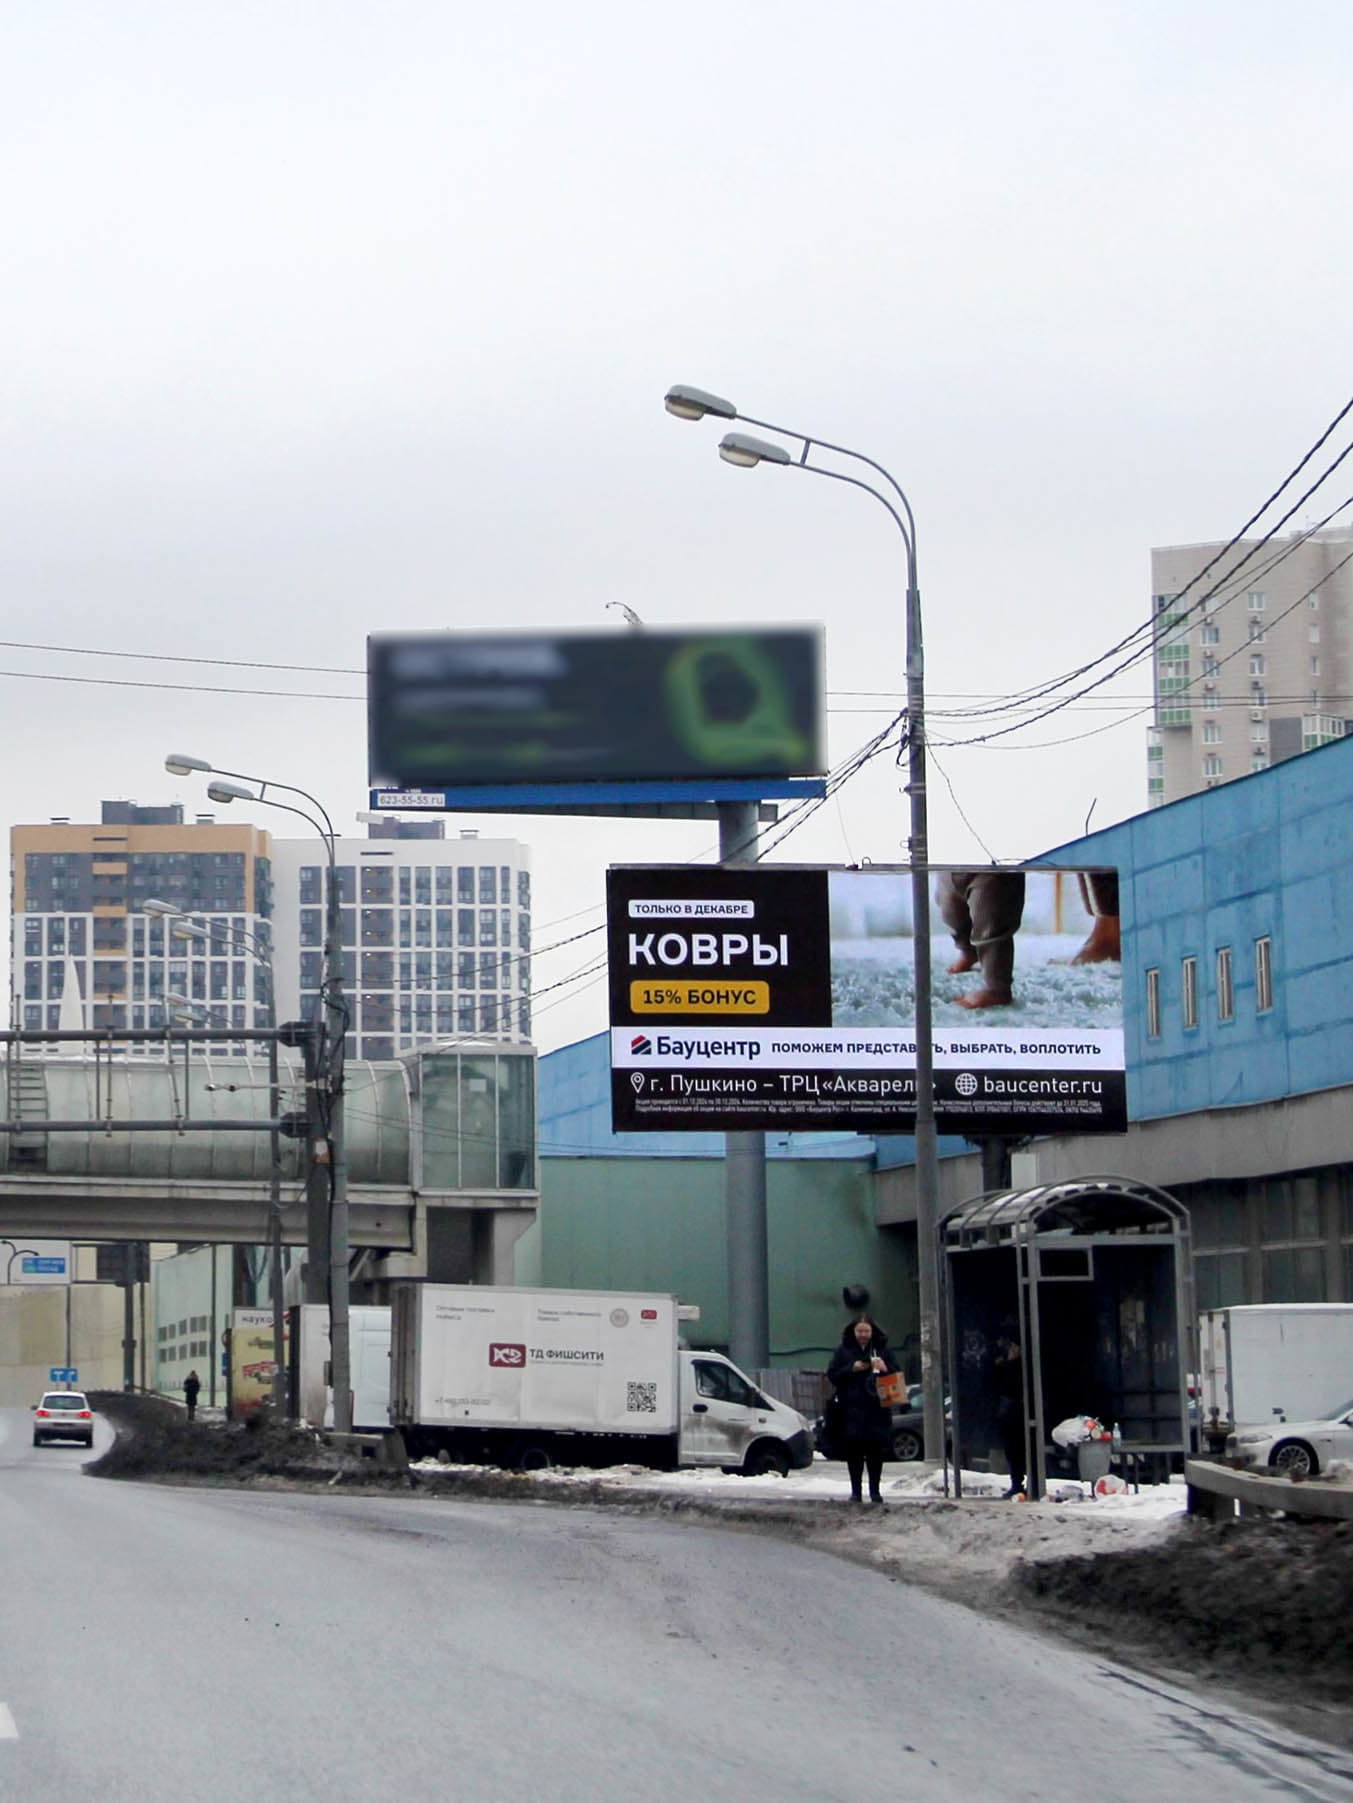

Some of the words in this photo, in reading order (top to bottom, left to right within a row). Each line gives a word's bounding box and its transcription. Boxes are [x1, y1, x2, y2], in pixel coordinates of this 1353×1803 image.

[635, 904, 681, 914] ТОЛЬКО
[685, 905, 692, 914] В
[695, 905, 748, 915] ДЕКАБРЕ
[629, 933, 788, 966] КОВРЫ
[643, 989, 682, 1004] 15%
[688, 989, 756, 1004] БОНУС
[657, 1036, 761, 1060] Бауцентр
[772, 1043, 843, 1053] ПОМОЖЕМ
[847, 1043, 947, 1055] ПРЕДСТАВЬ,
[951, 1043, 1017, 1055] ВЫБРАТЬ,
[1020, 1044, 1101, 1054] ВОПЛОТИТЬ
[650, 1078, 664, 1091] г.
[671, 1074, 757, 1095] Пушкино
[779, 1075, 820, 1095] ТРЦ
[822, 1075, 936, 1096] «Акварел
[984, 1076, 1102, 1093] baucenter.ru
[530, 1349, 544, 1359] ТД
[546, 1350, 604, 1360] ФИШСИТИ
